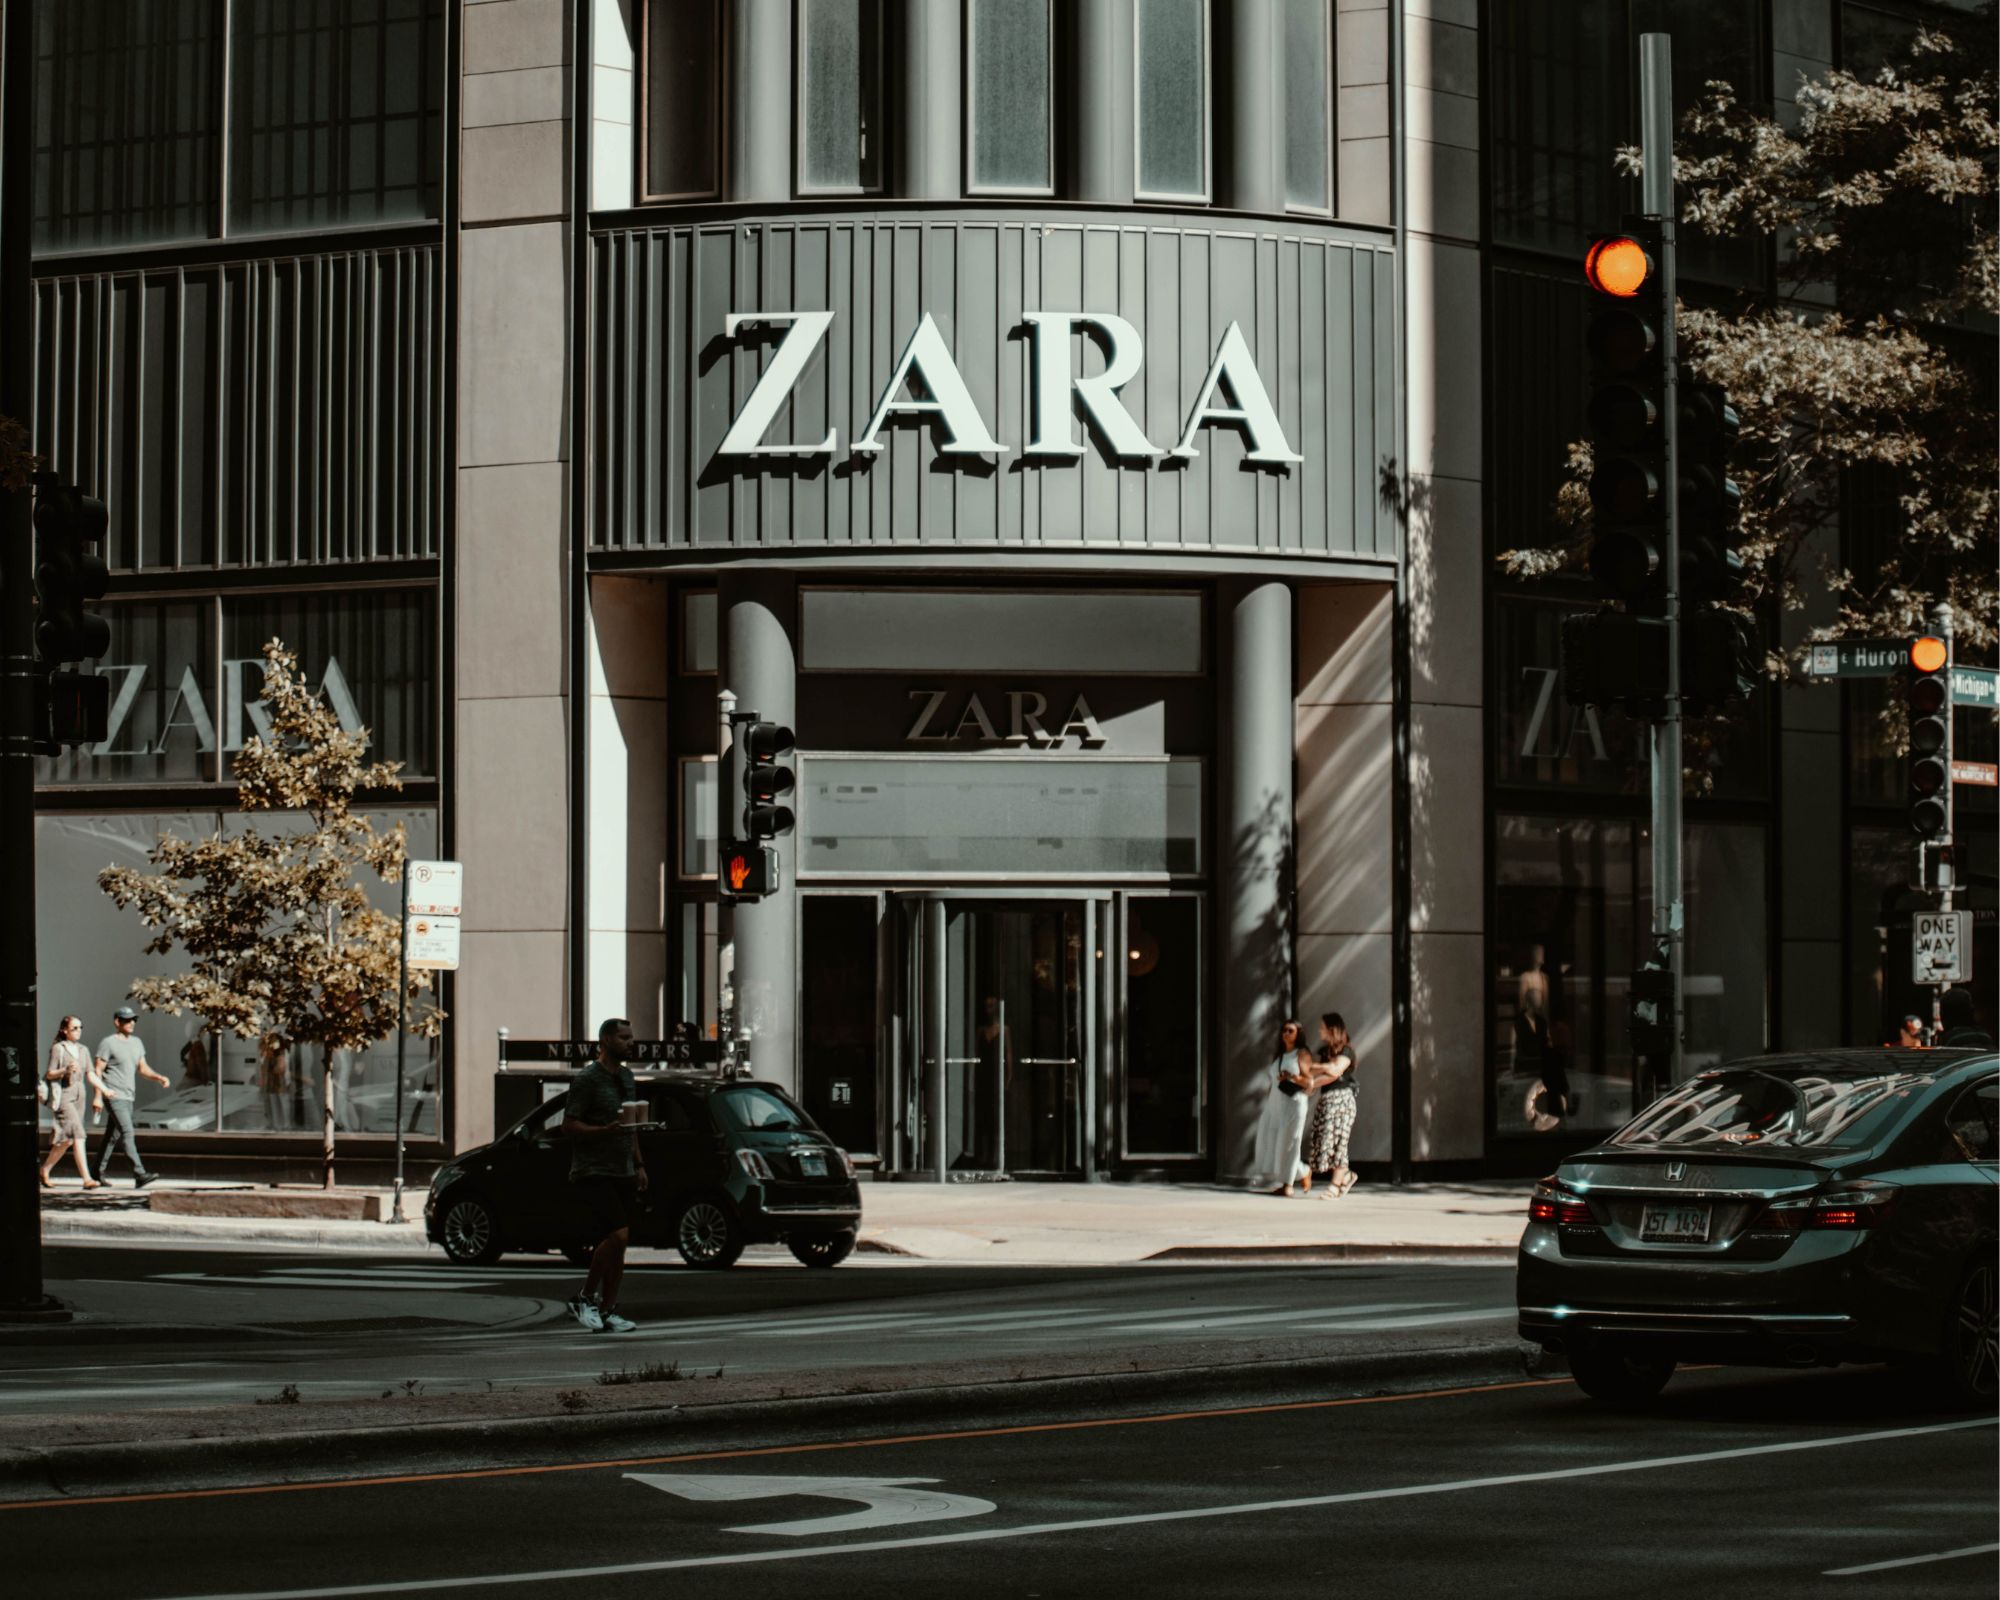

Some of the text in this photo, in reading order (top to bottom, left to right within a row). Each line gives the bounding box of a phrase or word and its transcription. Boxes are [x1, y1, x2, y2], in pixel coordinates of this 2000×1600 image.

[719, 311, 1304, 462] ZARA
[1855, 648, 1908, 667] Huron
[1955, 673, 1989, 702] Michigan
[905, 690, 1108, 741] ZARA
[1921, 918, 1955, 935] ONE
[1920, 937, 1955, 953] WAY
[547, 1043, 691, 1059] NEWSPERS
